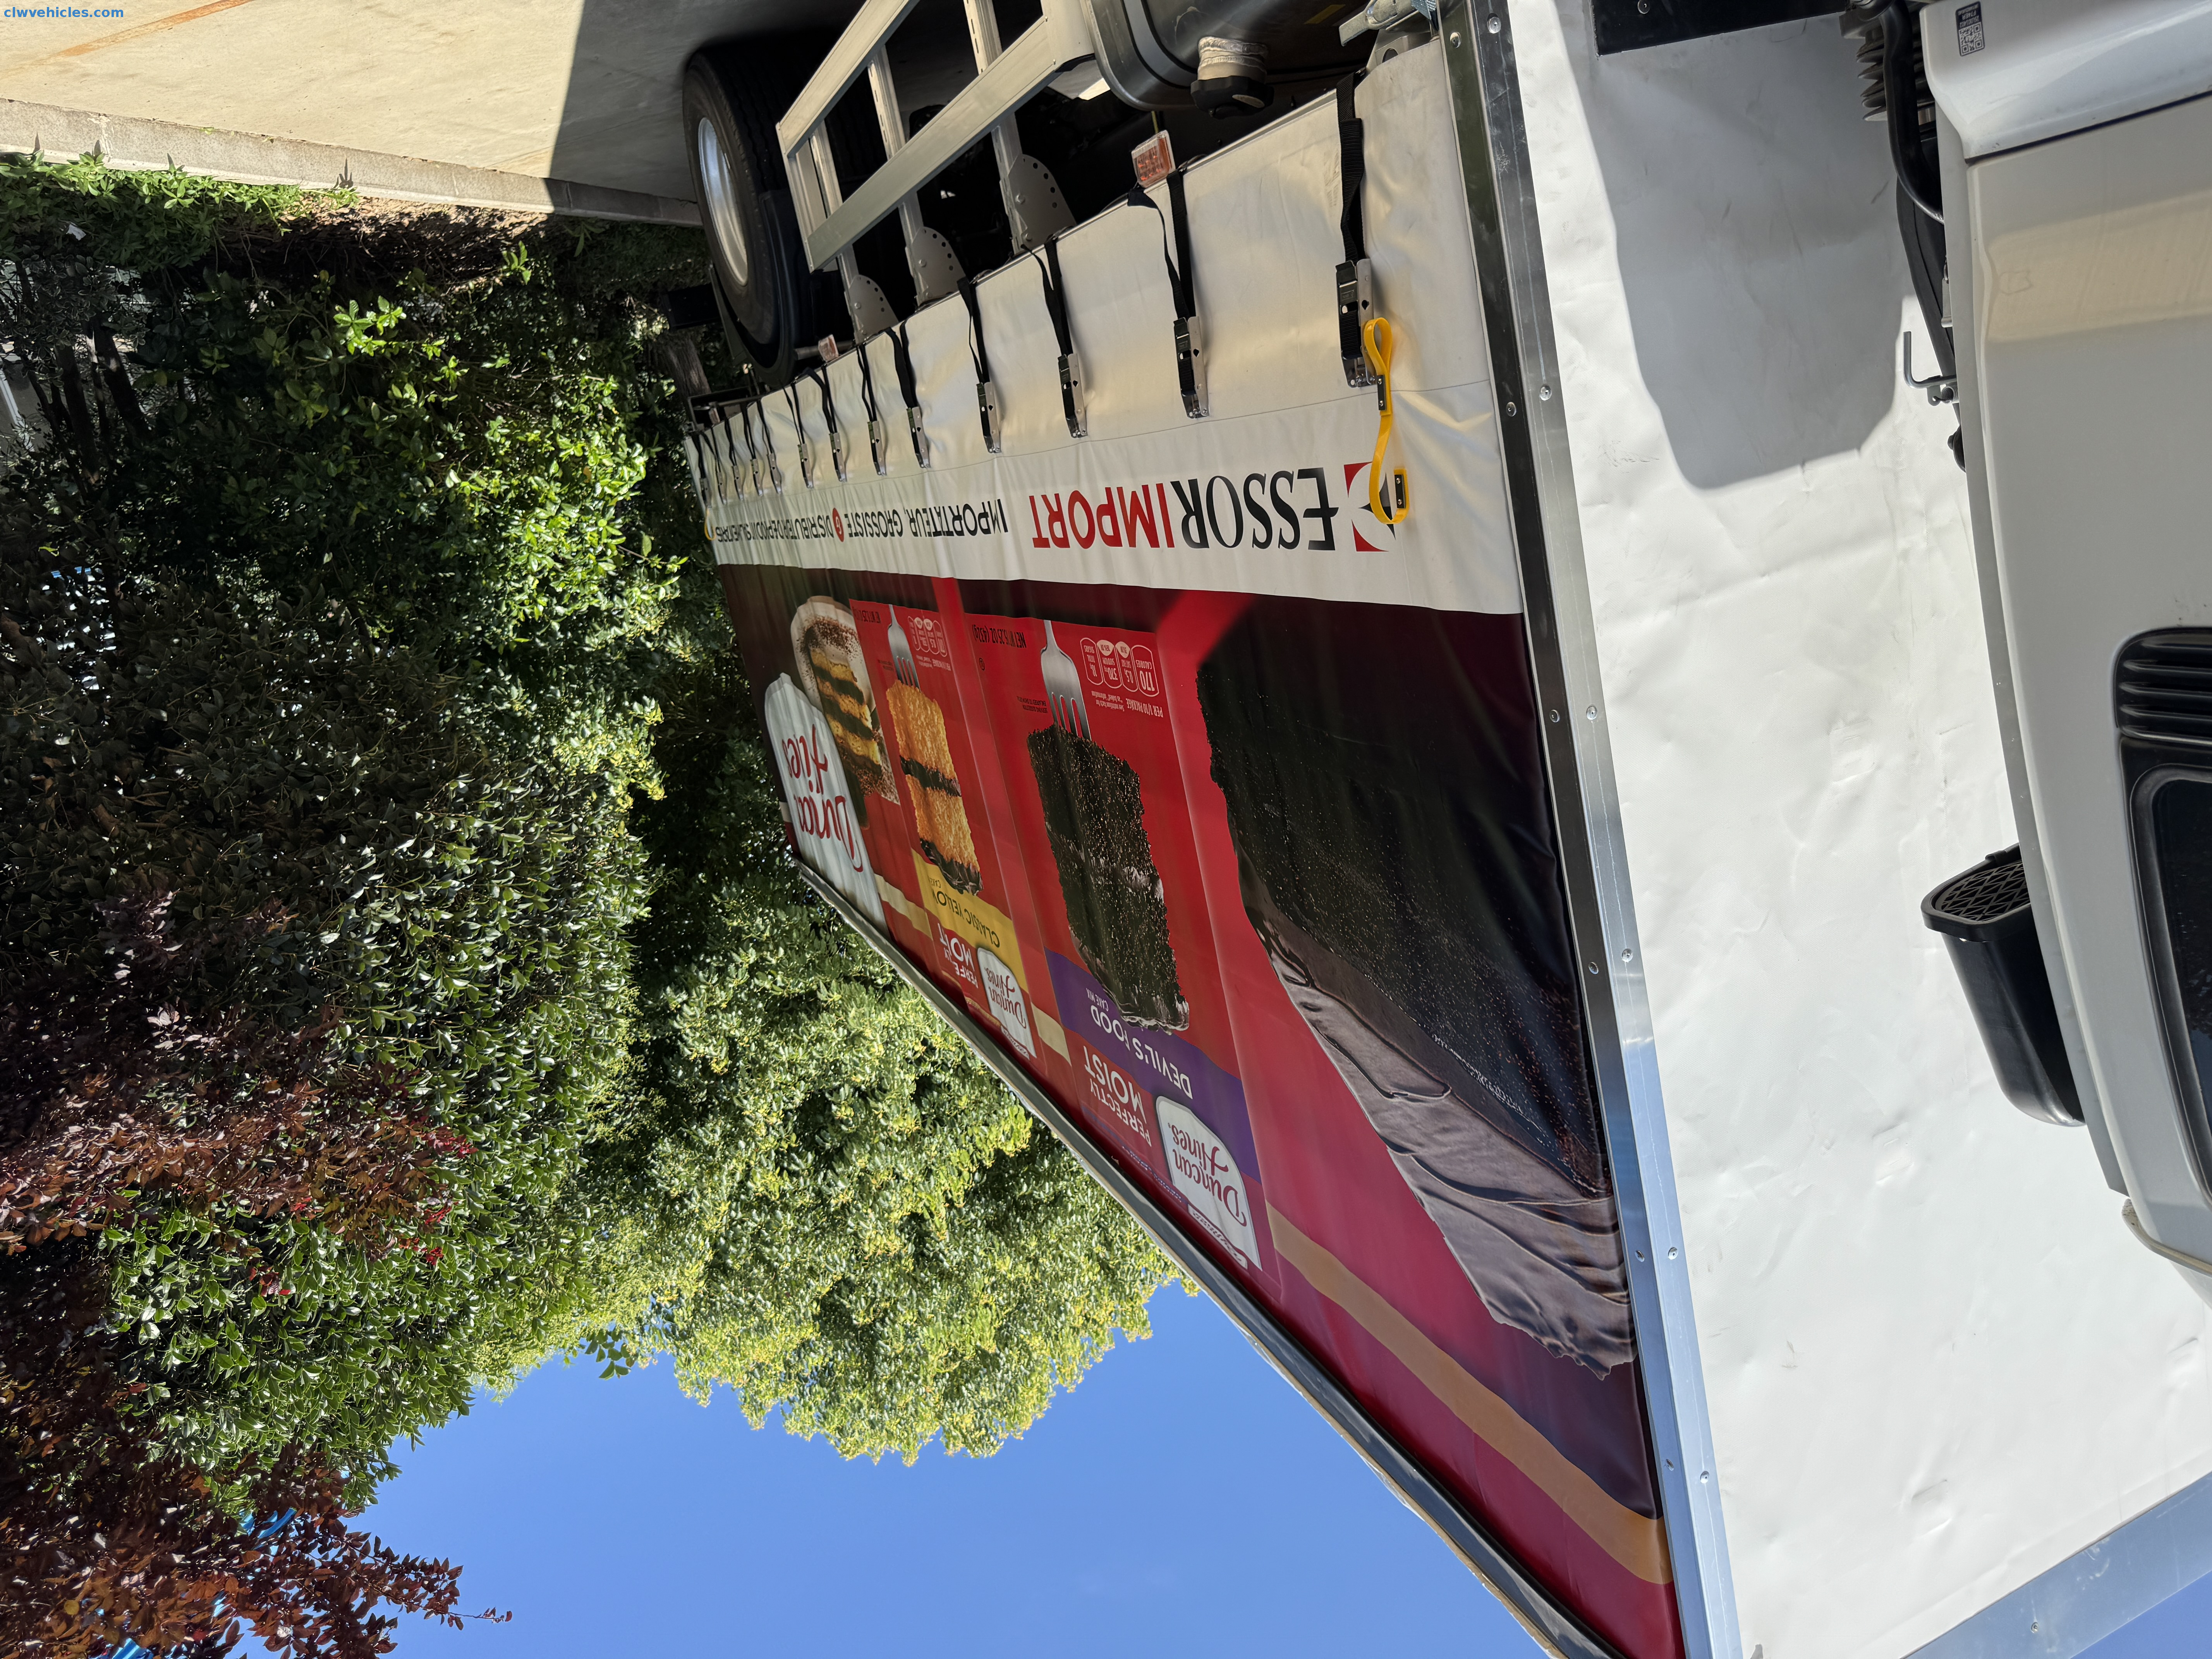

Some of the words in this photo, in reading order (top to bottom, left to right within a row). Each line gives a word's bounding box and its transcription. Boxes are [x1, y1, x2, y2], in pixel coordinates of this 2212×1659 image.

[844, 509, 903, 538] GROSSISTE
[1014, 632, 1027, 648] NET
[1135, 659, 1152, 669] CALORIES
[1139, 670, 1155, 691] 170
[1125, 698, 1144, 713] PACKAGE
[1143, 703, 1153, 715] 1/10
[1153, 705, 1163, 718] PER
[938, 923, 975, 971] MOIT
[944, 947, 978, 989] PERFELY
[1086, 988, 1096, 1002] MIX
[1096, 994, 1109, 1012] CAKE
[1091, 1005, 1130, 1051] FOOD
[1132, 1037, 1193, 1099] DEVIL'S
[1083, 1045, 1147, 1124] MOIST
[1090, 1079, 1151, 1147] PERFECTLY
[1171, 1125, 1228, 1176] Hines
[1173, 1149, 1247, 1227] Duncan
